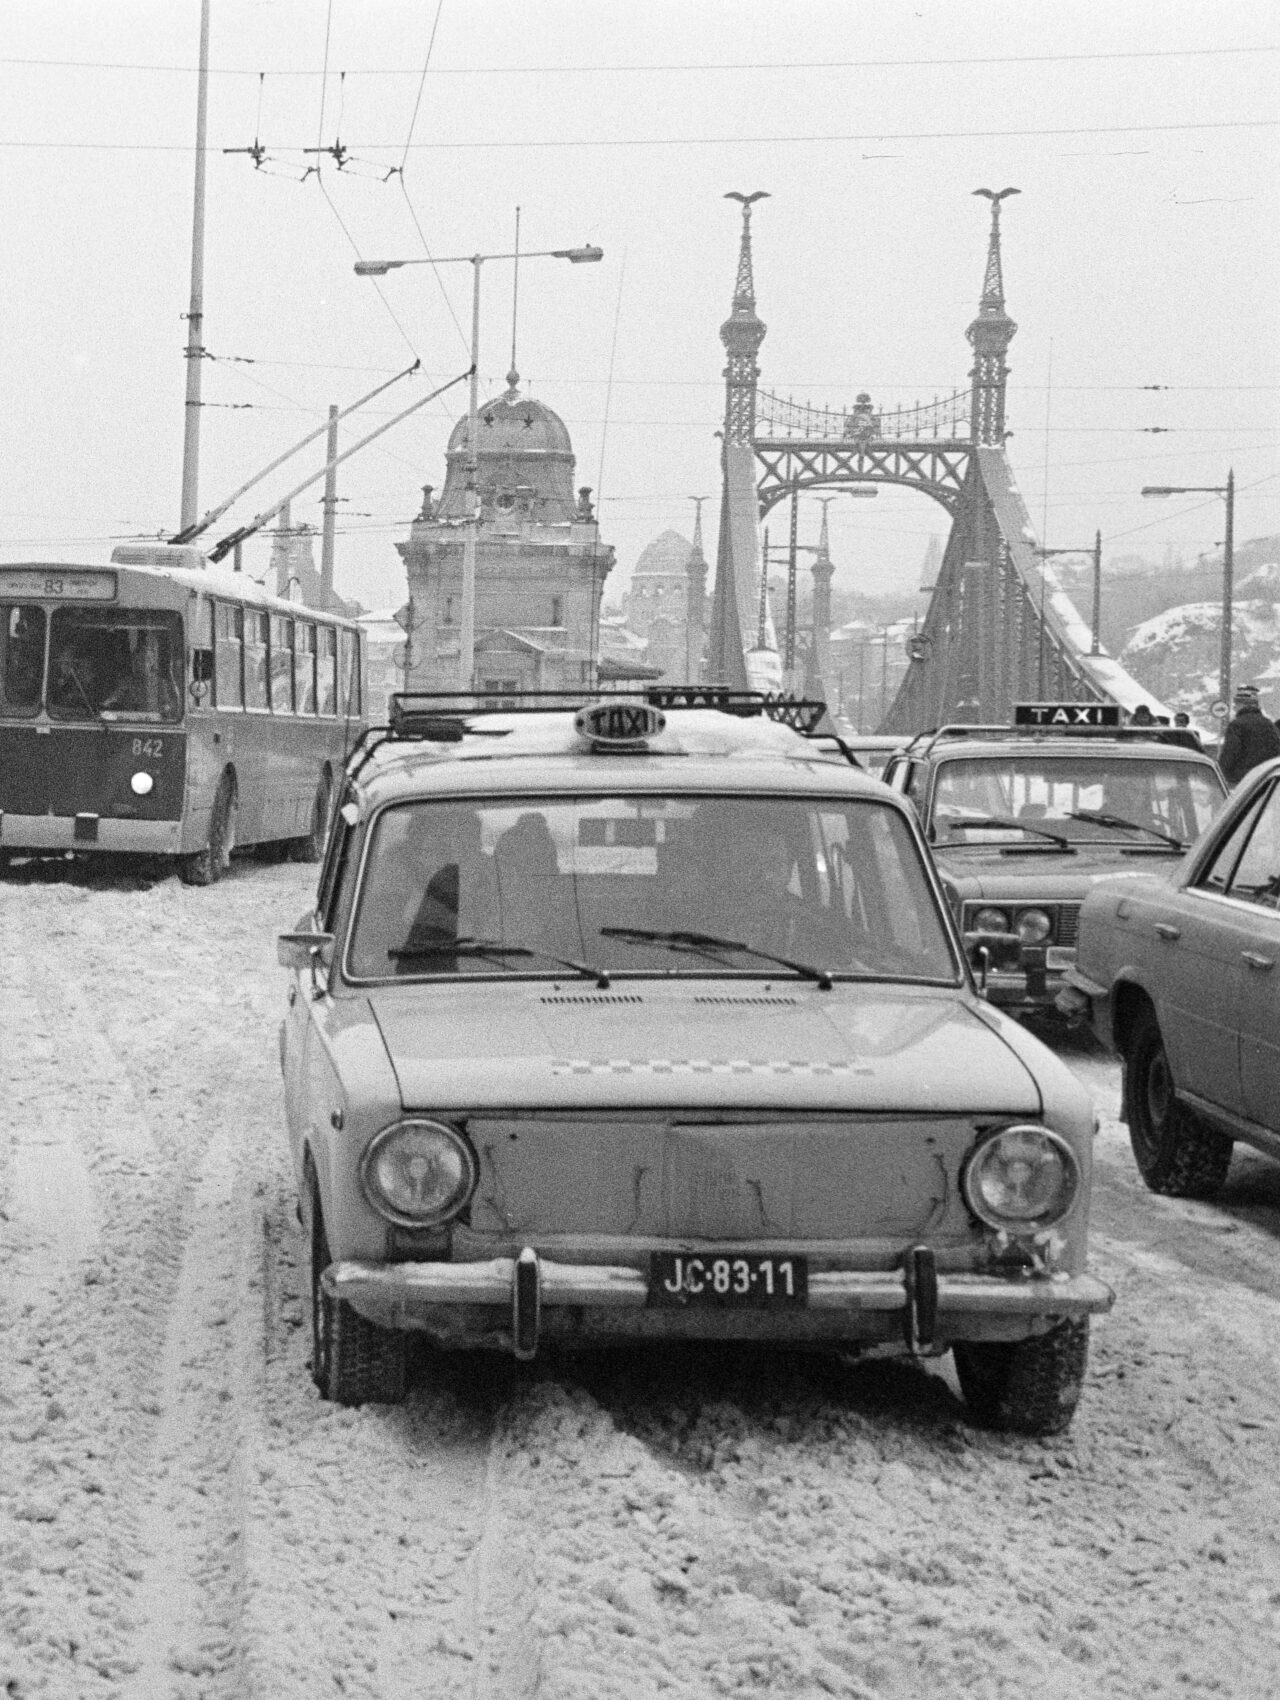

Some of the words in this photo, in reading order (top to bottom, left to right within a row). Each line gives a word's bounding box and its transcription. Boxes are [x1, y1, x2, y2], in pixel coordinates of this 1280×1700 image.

[44, 579, 63, 594] 83
[590, 708, 649, 737] TAXI
[1031, 708, 1102, 724] TAXI
[132, 738, 163, 758] 842
